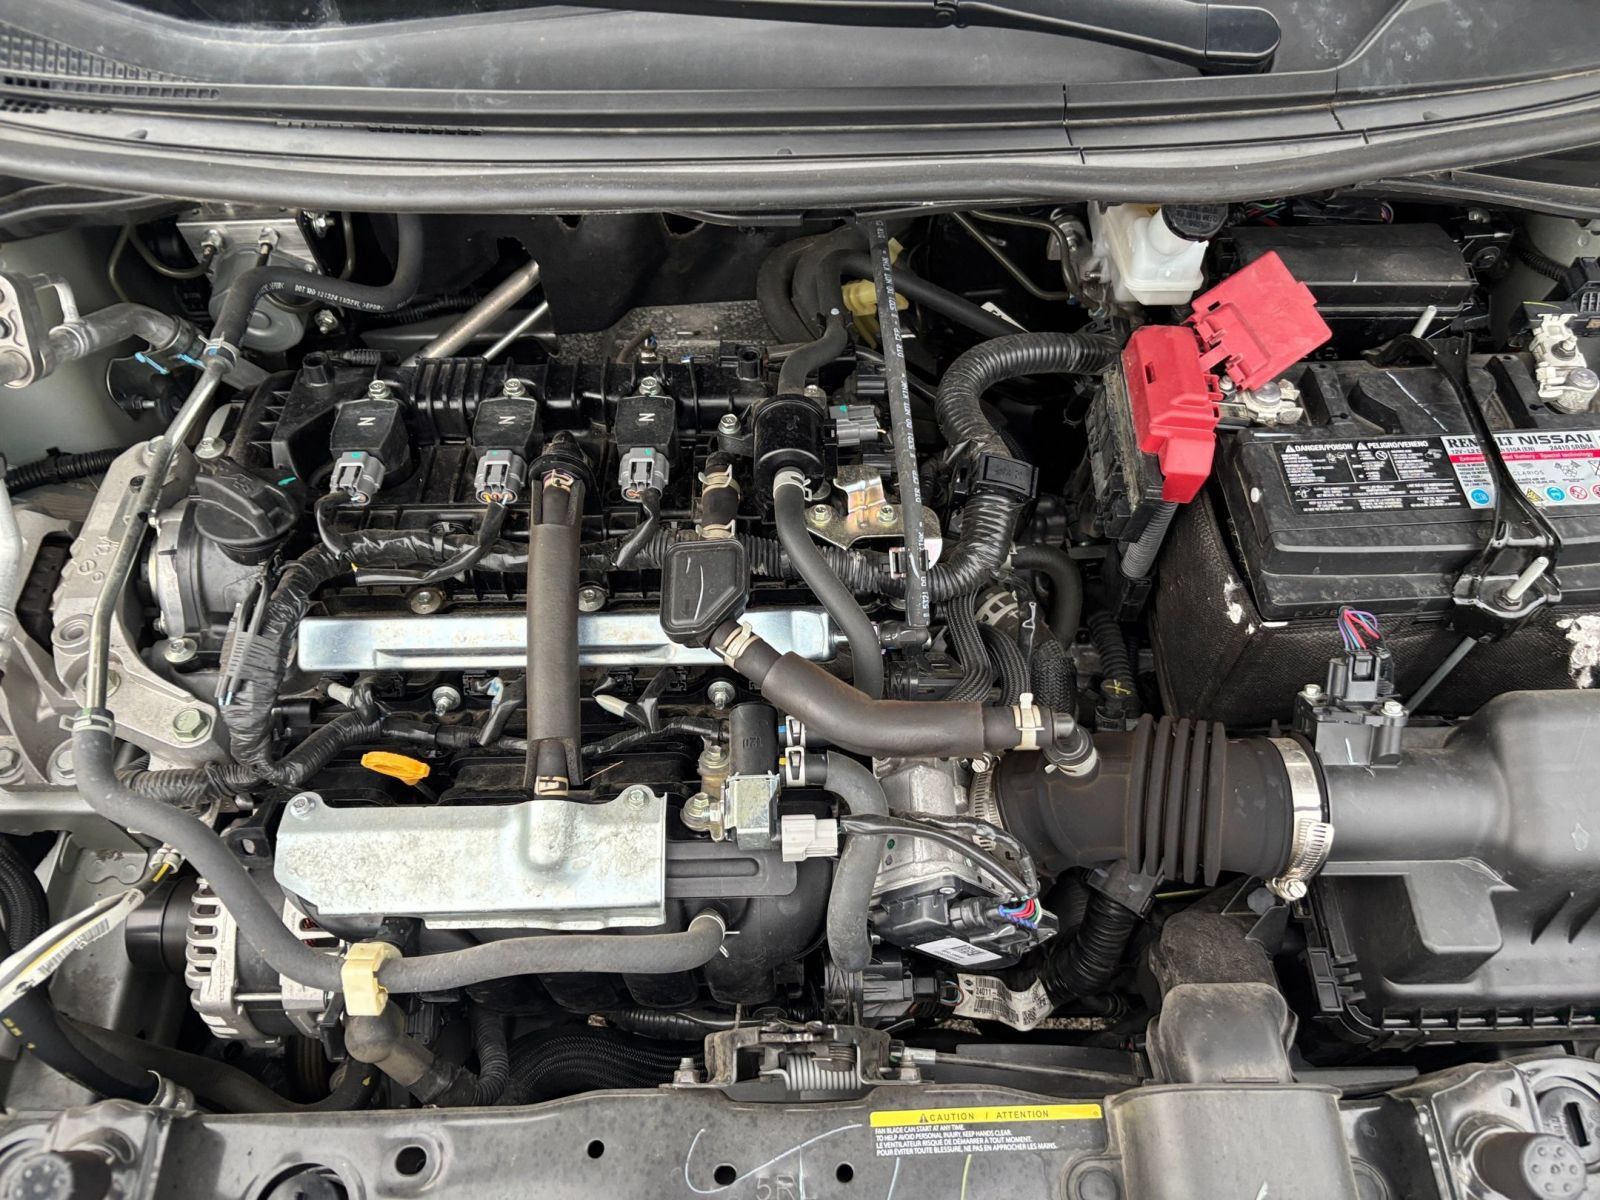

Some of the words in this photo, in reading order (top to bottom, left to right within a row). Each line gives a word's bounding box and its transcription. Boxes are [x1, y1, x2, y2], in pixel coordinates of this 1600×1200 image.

[903, 402, 911, 416] NOT
[1367, 440, 1429, 449] PELIGRO/VENENO
[1448, 436, 1512, 448] RENLT
[1520, 434, 1592, 445] NISSAN
[1294, 443, 1354, 452] DANGER/POISON
[930, 1112, 975, 1121] CAUTION
[996, 1110, 1049, 1119] ATTENTION
[883, 1140, 922, 1148] VENTILATEUR
